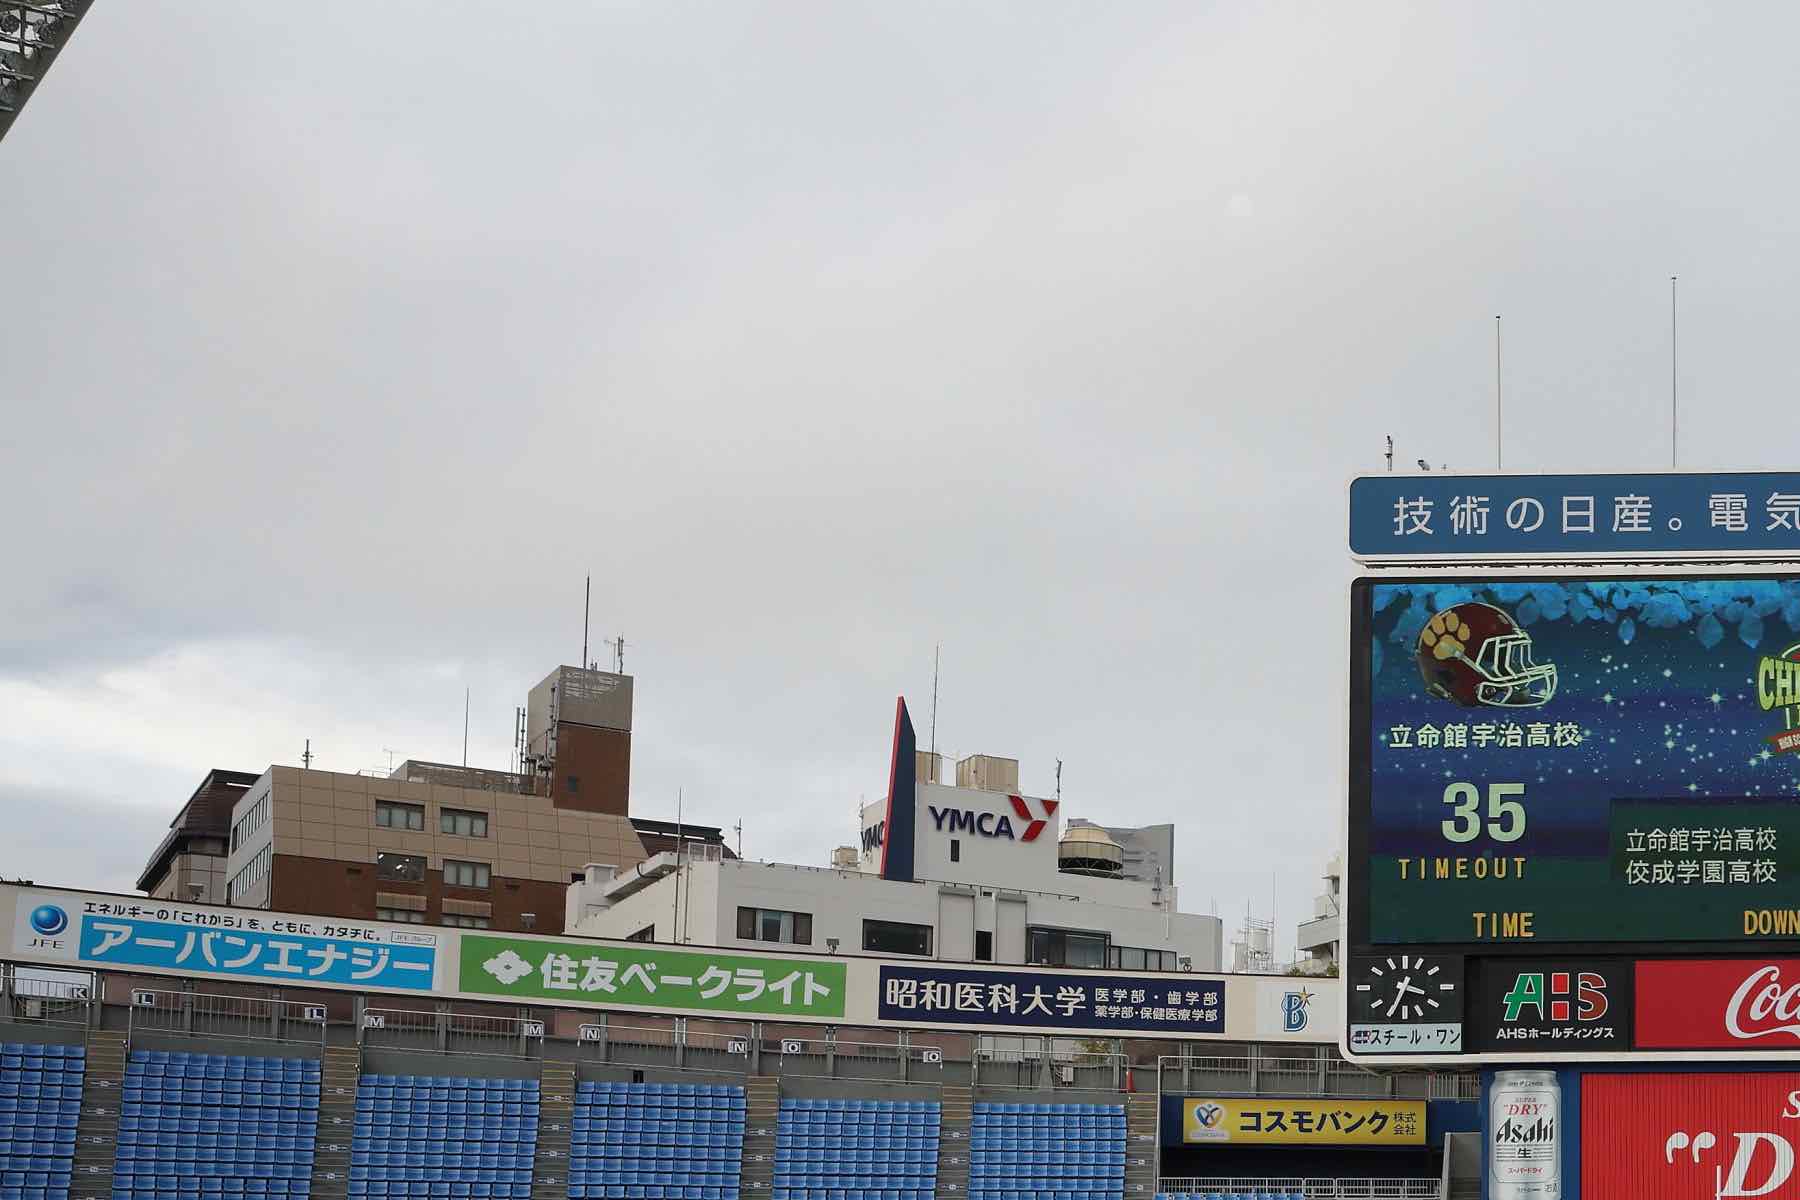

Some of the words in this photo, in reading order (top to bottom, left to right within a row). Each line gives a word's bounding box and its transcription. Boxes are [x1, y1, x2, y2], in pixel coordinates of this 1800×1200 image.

[1389, 722, 1580, 749] 立命館宇治高校
[928, 805, 1015, 840] YMCA
[1441, 782, 1527, 843] 35
[1625, 828, 1777, 853] 立命館宇治高校
[1398, 857, 1527, 879] TIMEOUT
[1625, 859, 1777, 885] 佼成学園高校
[1472, 912, 1534, 938] TIME
[25, 938, 65, 950] JFE
[92, 922, 430, 980] アーバンエナジー
[540, 952, 831, 1007] 住友ベークライト
[73, 988, 87, 998] K
[885, 976, 1087, 1018] 昭和医科大学
[370, 1017, 383, 1027] M
[529, 1025, 542, 1035] M
[1496, 1027, 1615, 1040] AHSホールディングス
[1371, 1028, 1461, 1046] スチール・ワン
[1239, 1110, 1389, 1135] コスモバンク
[1496, 1116, 1554, 1144] Asahi
[1517, 1147, 1532, 1159] 生
